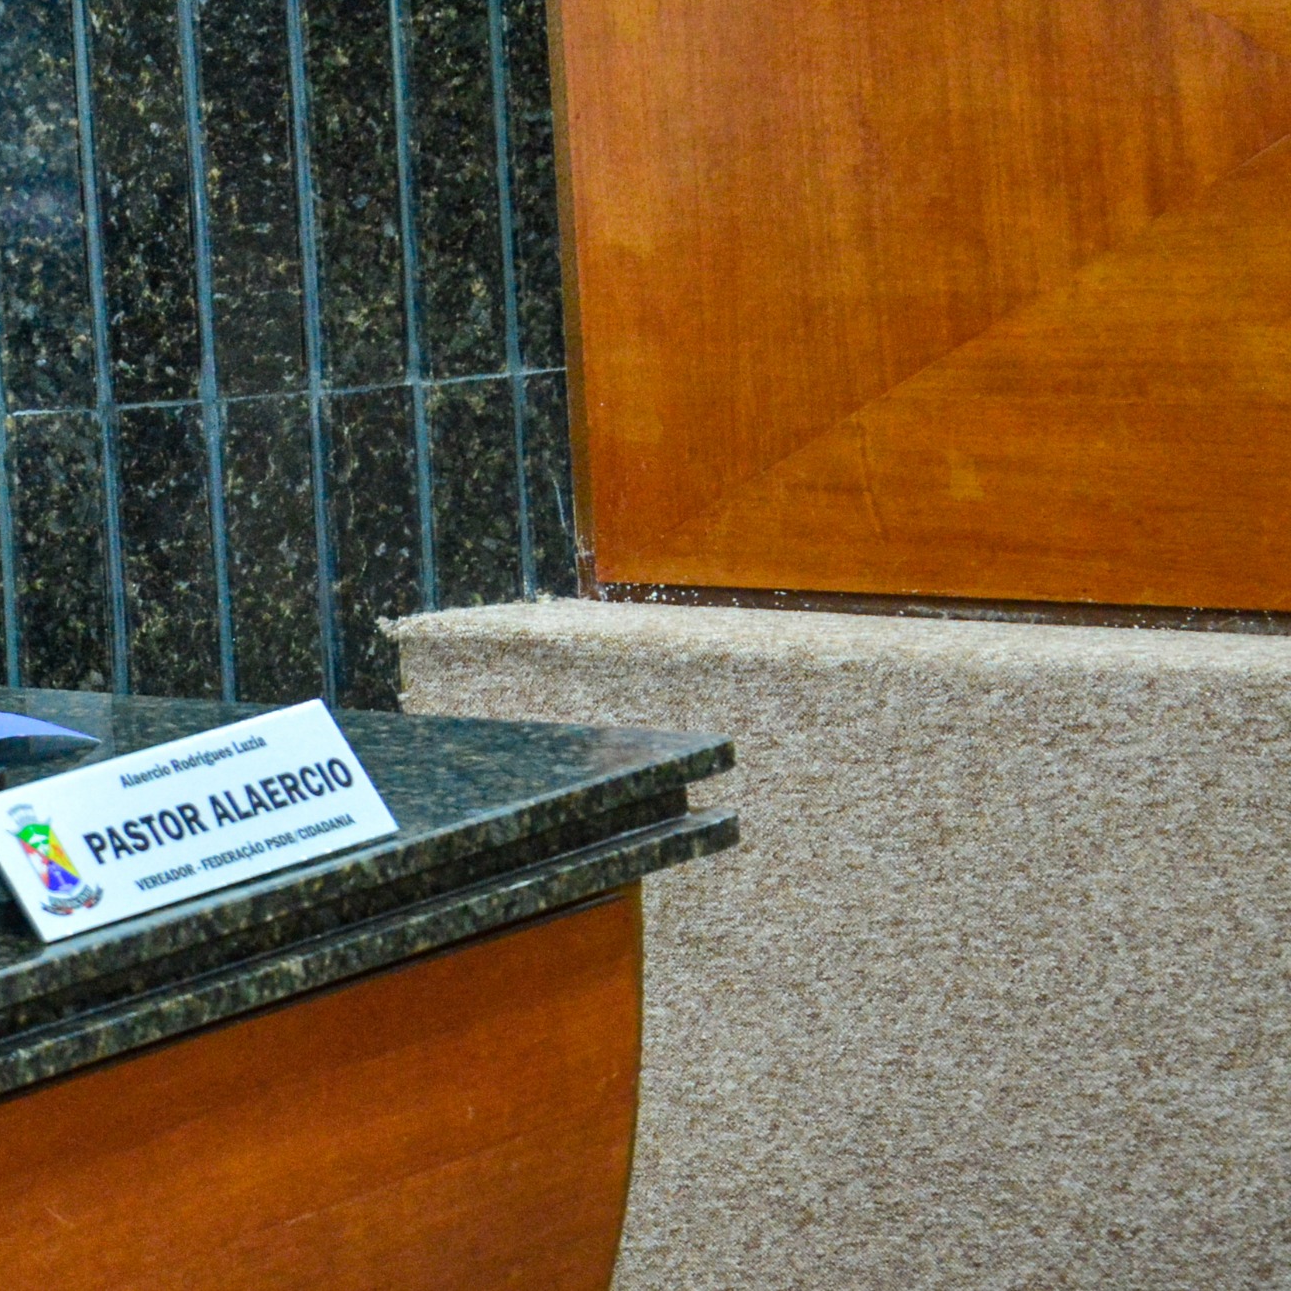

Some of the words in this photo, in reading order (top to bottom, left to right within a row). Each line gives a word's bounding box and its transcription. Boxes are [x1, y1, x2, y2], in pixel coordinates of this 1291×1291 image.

[119, 763, 170, 789] Alaercio
[170, 745, 234, 773] Rodrigues
[232, 734, 267, 755] Luzia
[83, 802, 209, 865] PASTOR
[208, 757, 354, 827] ALAERCIO
[134, 863, 197, 892] VEREADOR
[200, 839, 265, 872] FEDERAÇÃO
